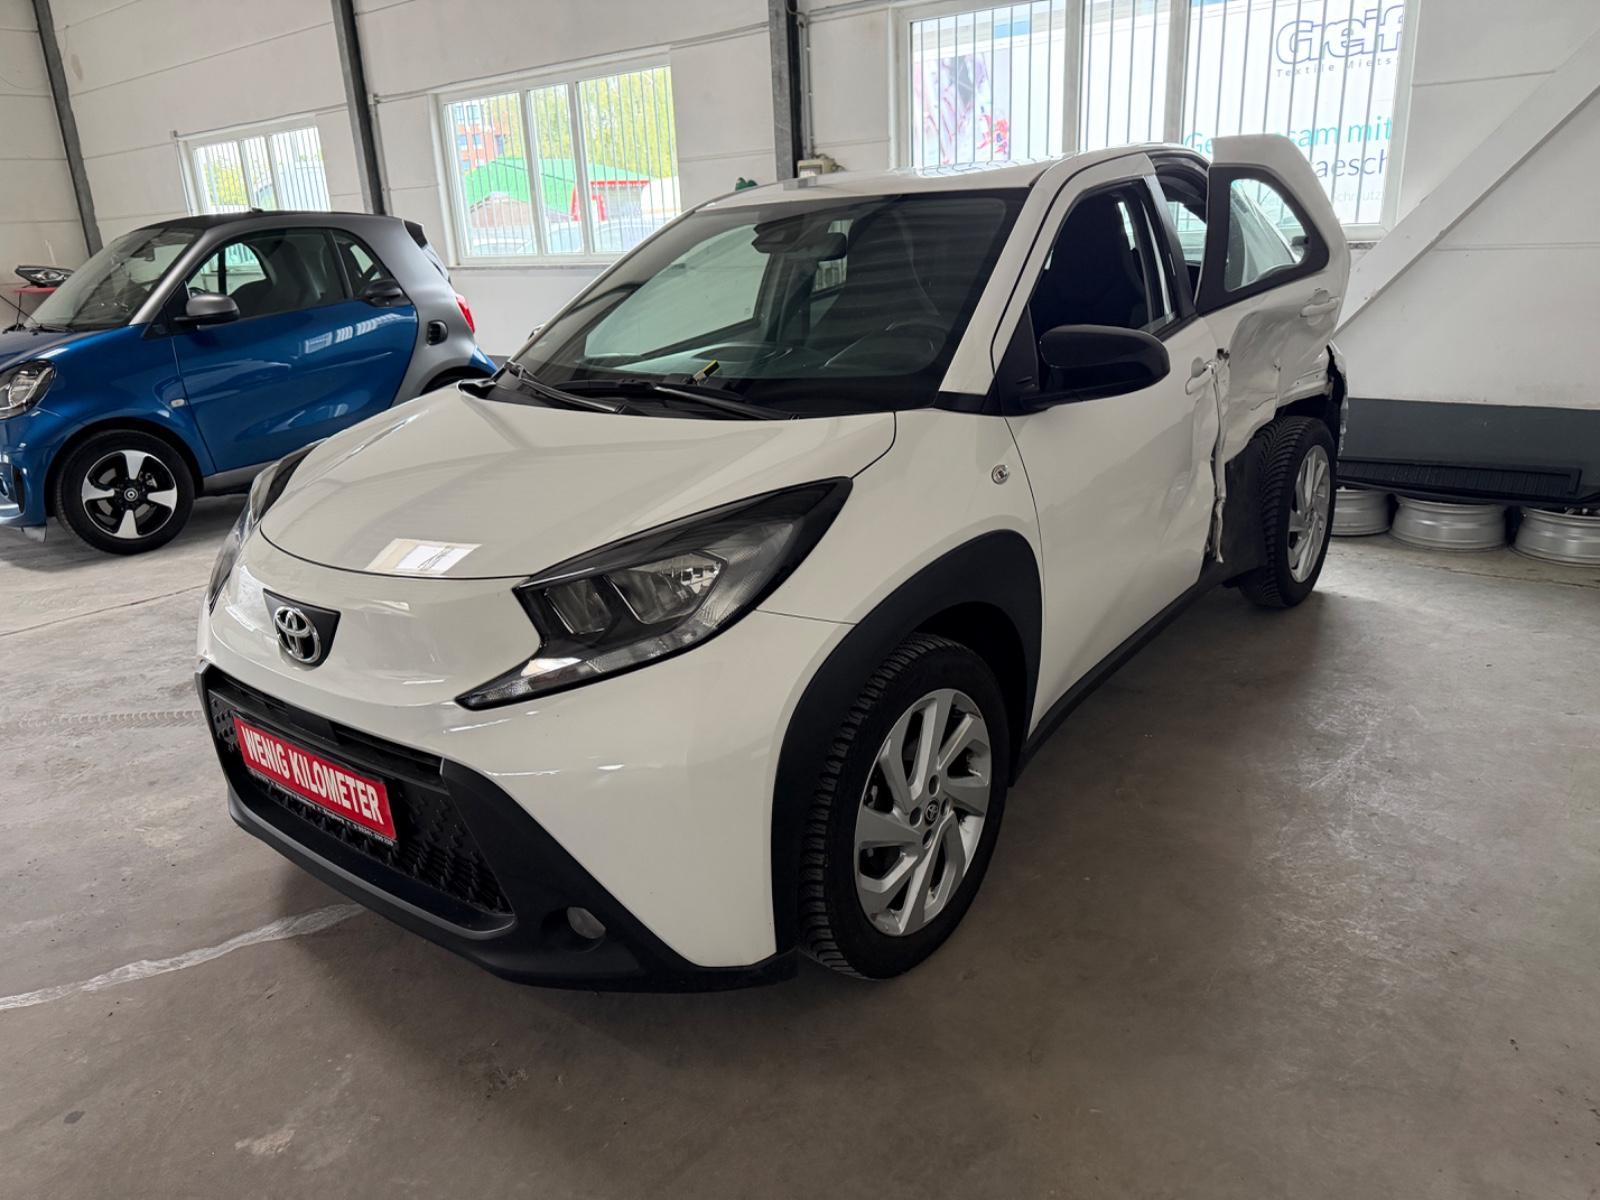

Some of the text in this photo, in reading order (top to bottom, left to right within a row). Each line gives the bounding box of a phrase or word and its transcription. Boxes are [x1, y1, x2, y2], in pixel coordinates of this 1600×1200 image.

[1348, 115, 1392, 143] mit
[241, 726, 290, 779] WENIG
[288, 749, 384, 825] KILOMETER
